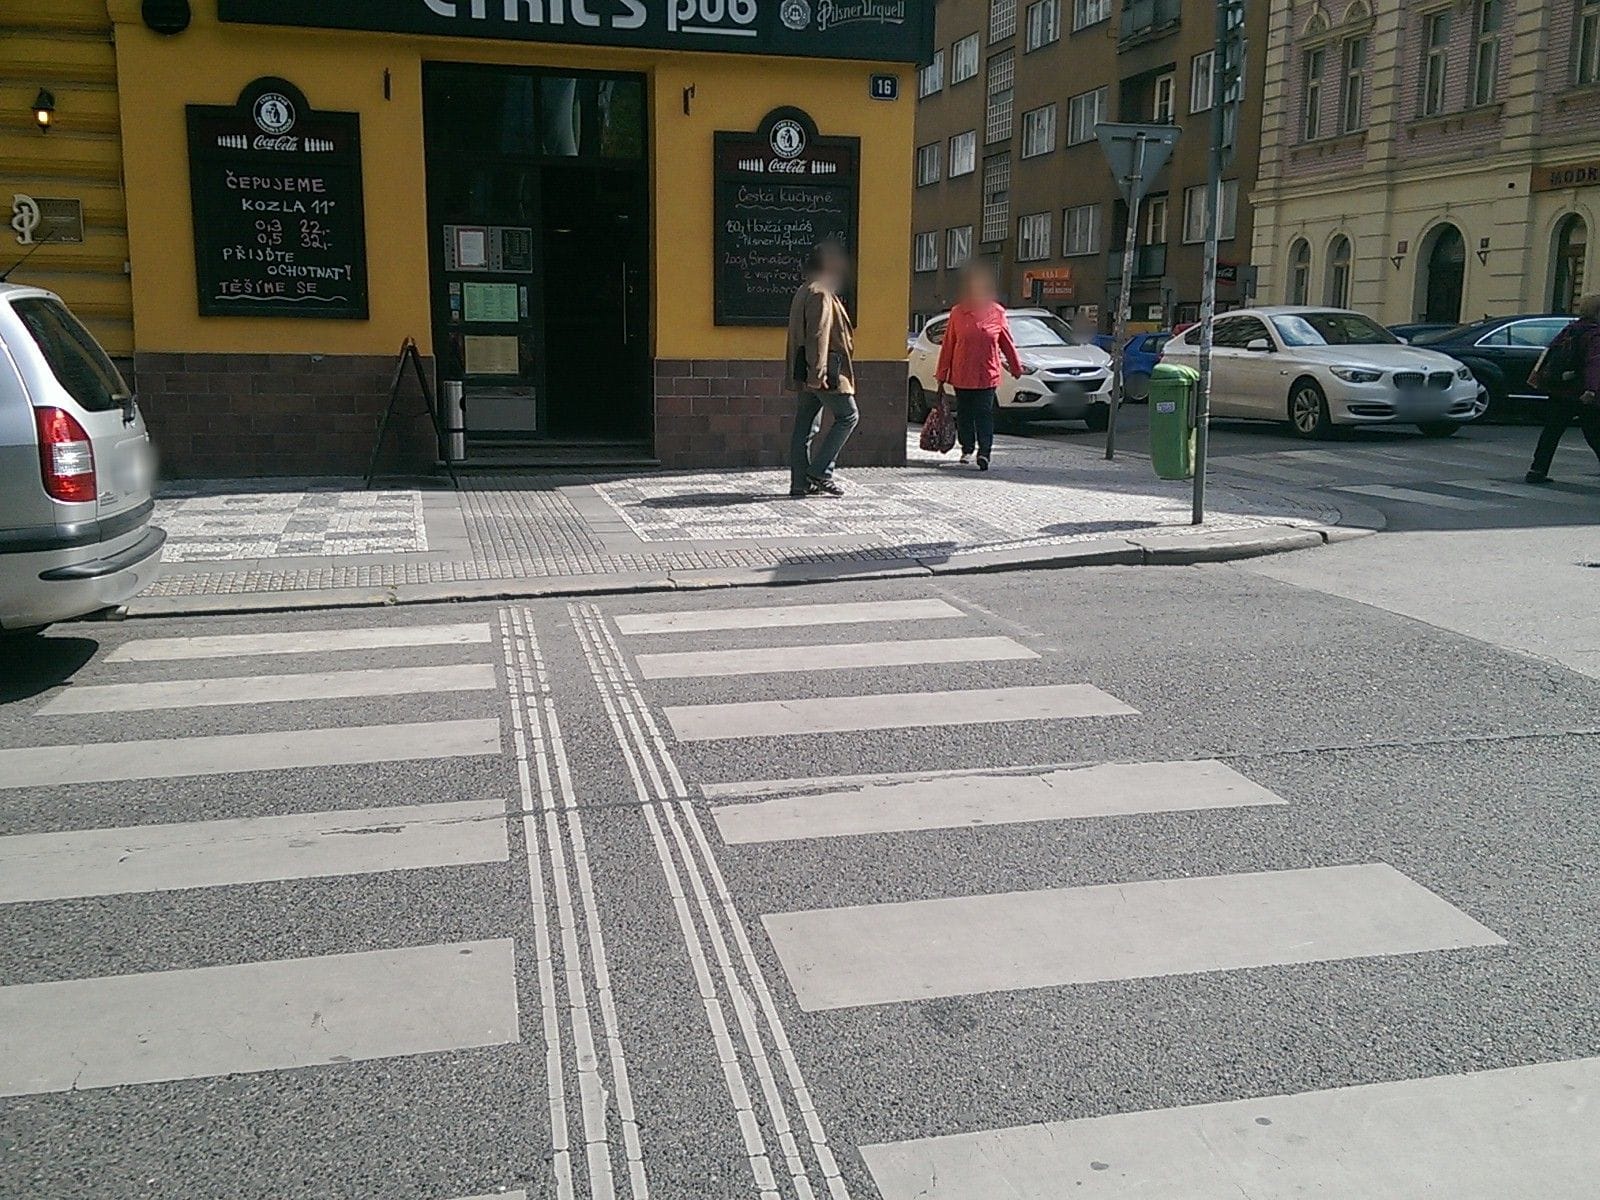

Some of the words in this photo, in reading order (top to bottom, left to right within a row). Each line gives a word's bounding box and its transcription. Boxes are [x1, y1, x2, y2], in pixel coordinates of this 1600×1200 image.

[878, 79, 891, 94] 16
[226, 169, 326, 192] ČEPUJEME
[242, 198, 306, 213] KOZLA
[255, 219, 282, 232] 0,3
[257, 233, 282, 246] 0,5
[267, 264, 352, 281] OCHUTNAT!
[219, 278, 285, 294] TĚŠÍME
[296, 281, 317, 294] SE
